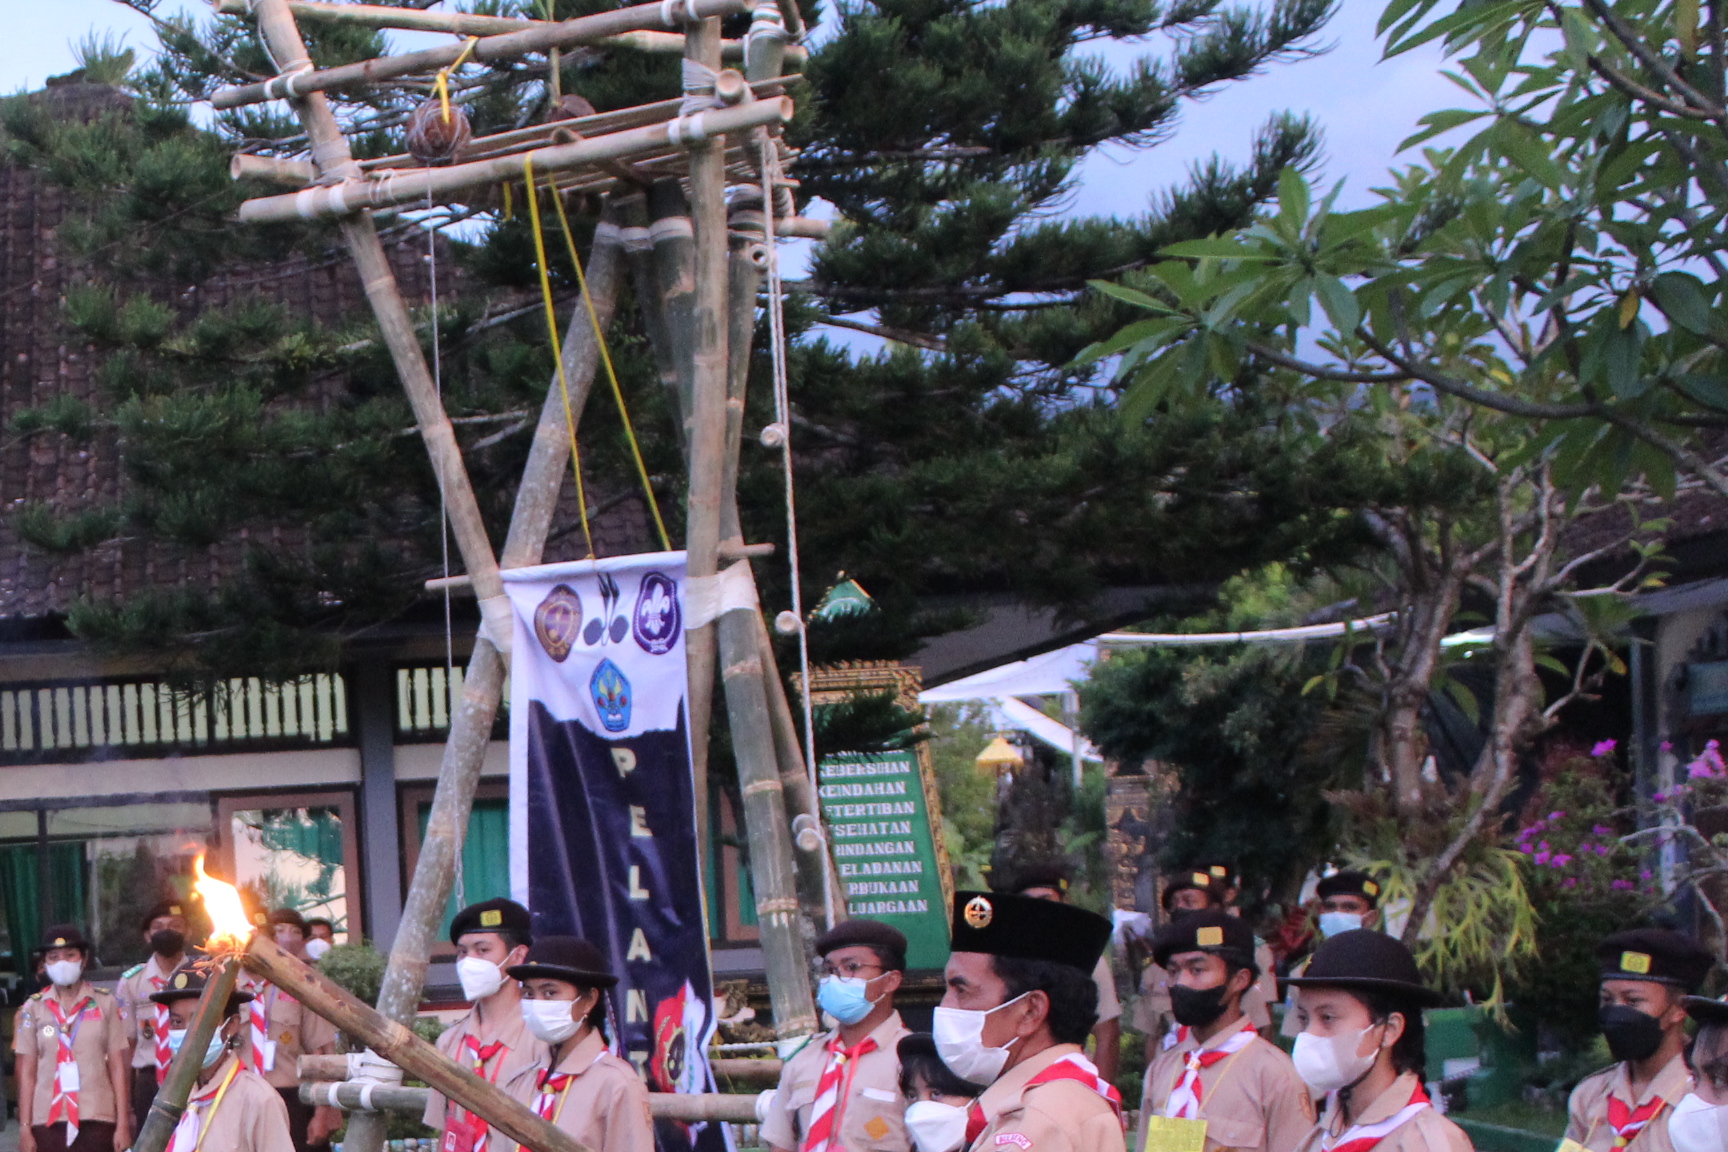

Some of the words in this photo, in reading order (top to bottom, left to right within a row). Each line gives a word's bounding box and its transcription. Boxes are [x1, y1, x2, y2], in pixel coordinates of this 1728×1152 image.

[829, 821, 911, 837] SEHATAN
[835, 841, 915, 856] INDANGAN
[839, 861, 923, 876] ELADANAN
[848, 880, 920, 896] RBUKAAN
[848, 900, 929, 915] LUARGAAN
